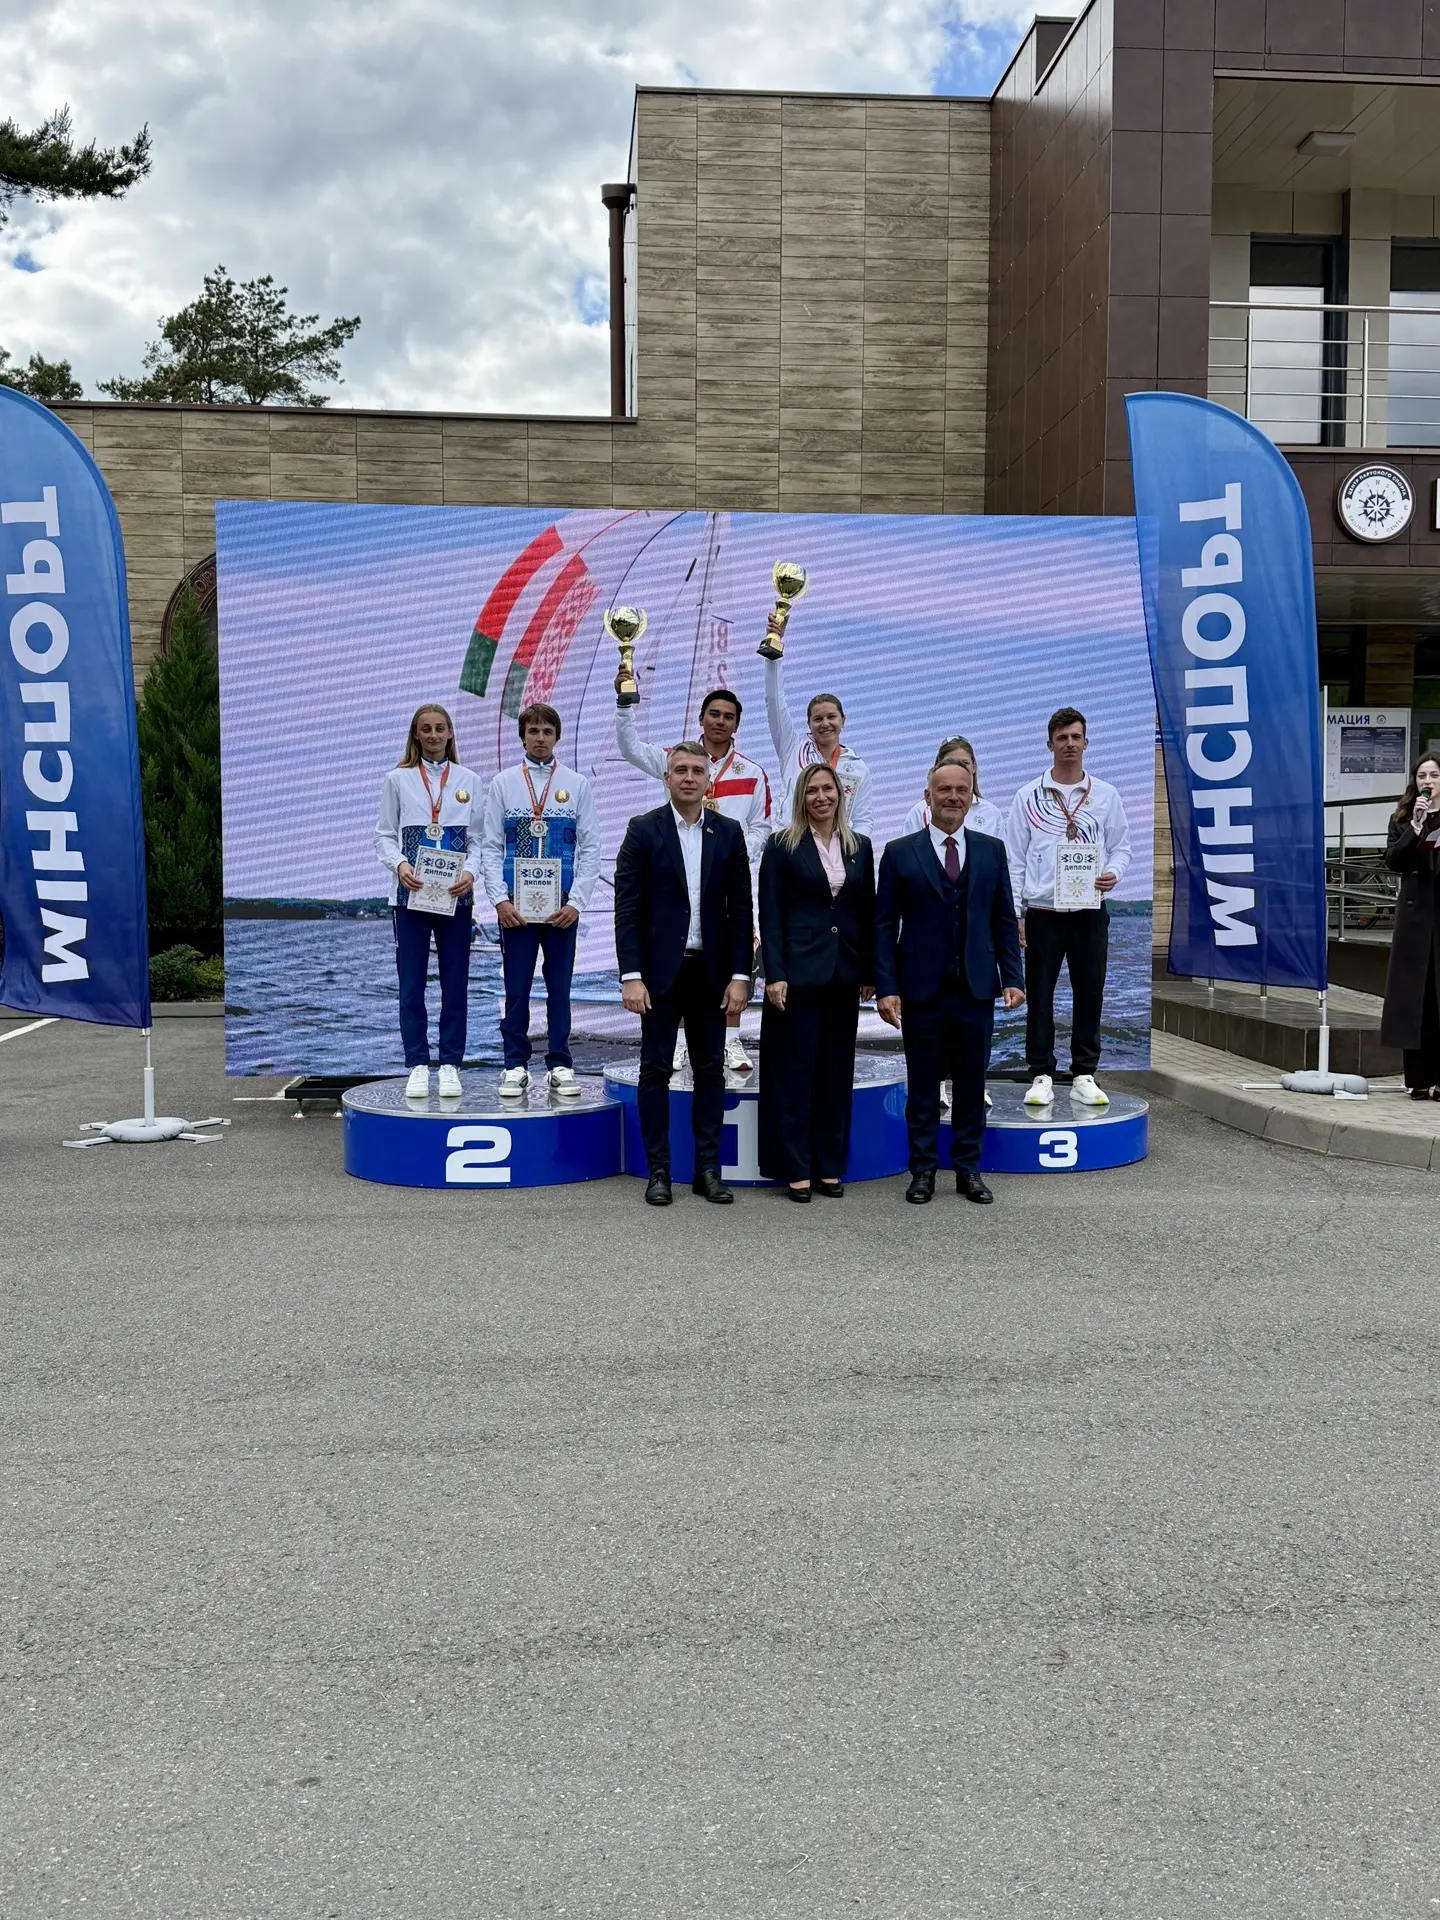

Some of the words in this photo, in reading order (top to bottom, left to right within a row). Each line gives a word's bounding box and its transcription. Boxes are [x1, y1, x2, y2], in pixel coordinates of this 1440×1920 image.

[1347, 479, 1359, 495] ЦЕНТР
[1359, 470, 1392, 480] ПАРУСНОГО
[1392, 476, 1406, 495] СПОРТА
[1327, 714, 1371, 726] МАЦИЯ
[424, 868, 453, 878] ДИПЛОМ
[445, 1126, 512, 1183] 2
[720, 1100, 760, 1181] 1
[1038, 1130, 1079, 1169] 3
